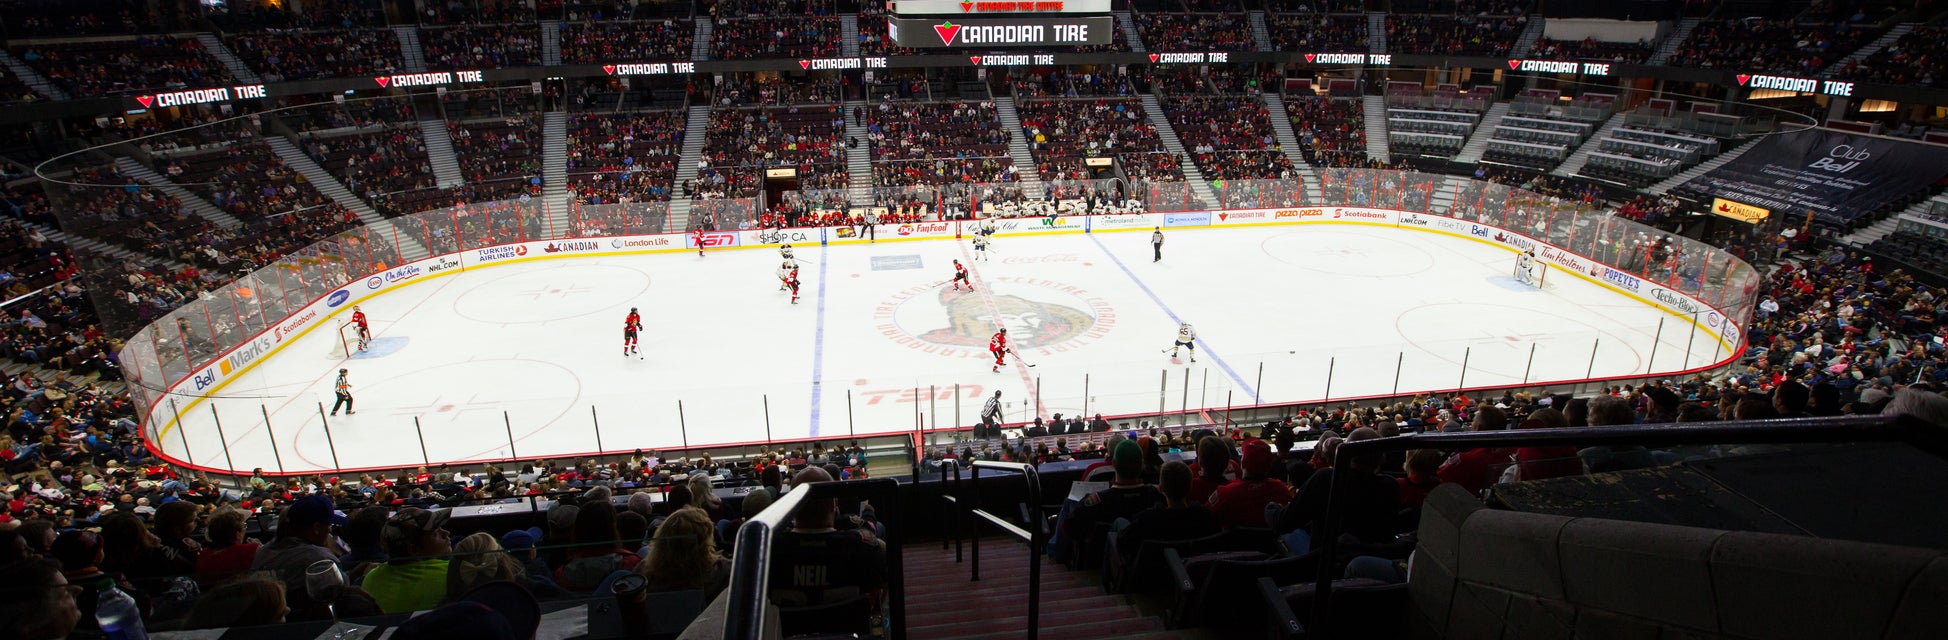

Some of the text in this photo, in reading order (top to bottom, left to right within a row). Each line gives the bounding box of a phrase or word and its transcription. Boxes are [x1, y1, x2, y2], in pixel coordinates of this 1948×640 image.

[1018, 2, 1034, 12] TIRE
[961, 24, 1088, 43] CANADIAN TIRE
[811, 57, 887, 70] CANADIAN TIRE
[982, 54, 1054, 66] CANADIAN TIRE
[1160, 52, 1228, 63] CANADIAN TIRE
[1316, 53, 1392, 65] CANADIAN TIRE
[617, 62, 695, 75] CANADIAN TIRE
[1521, 60, 1609, 76] CANADIAN TIRE
[391, 70, 483, 87] CANADIAN TIRE
[1750, 74, 1854, 96] CANADIAN TIRE
[156, 85, 266, 107] CANADIAN TIRE
[1830, 144, 1871, 161] Club
[1808, 157, 1860, 173] Bell
[1275, 209, 1323, 219] pizza pizza
[1344, 210, 1387, 220] Scotiabank
[1729, 205, 1762, 218] CANADIAN
[1472, 224, 1488, 237] Bell
[558, 241, 599, 253] CANADIAN
[624, 238, 669, 247] London Life
[478, 246, 514, 256] TURKISH
[479, 252, 515, 262] AIRLINES
[1541, 245, 1586, 273] Tim Hortons
[429, 260, 459, 272] NHL.COM
[385, 265, 420, 282] On the Run
[1604, 267, 1641, 289] POPEYE'S
[283, 309, 317, 335] Scotiabank
[229, 337, 271, 371] Mark's
[195, 368, 216, 391] Bell
[793, 564, 830, 587] NEIL
